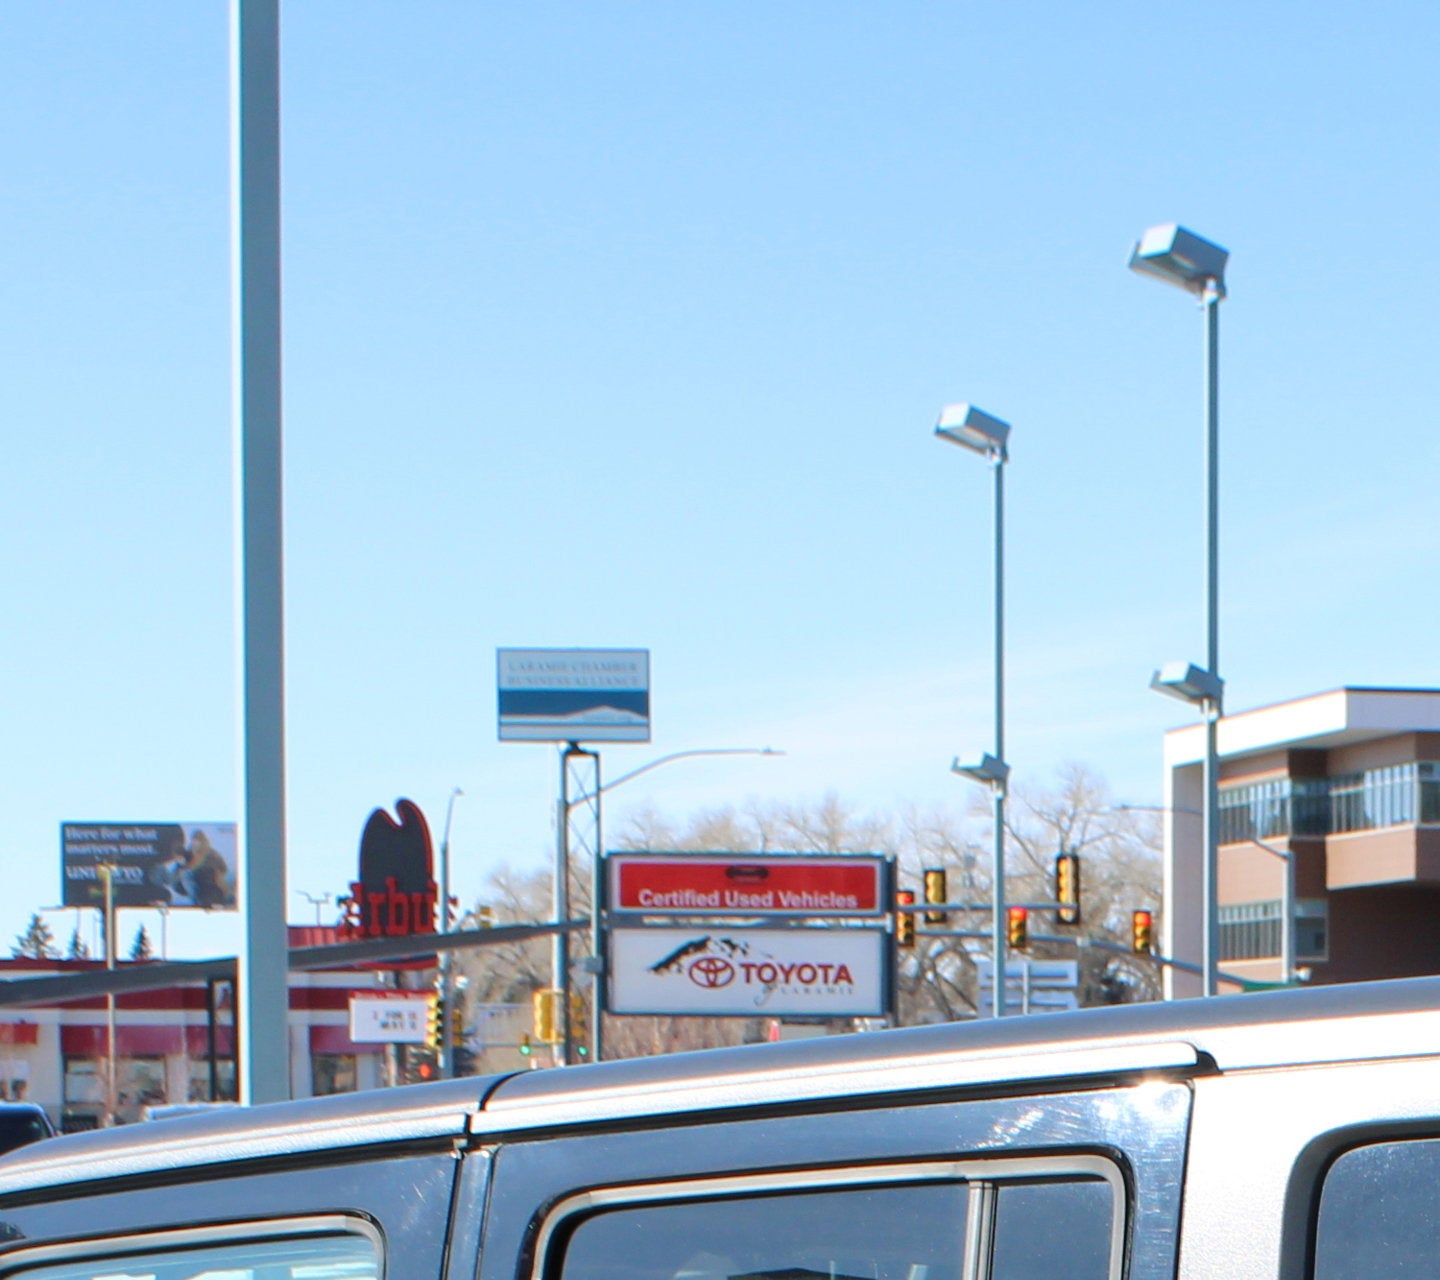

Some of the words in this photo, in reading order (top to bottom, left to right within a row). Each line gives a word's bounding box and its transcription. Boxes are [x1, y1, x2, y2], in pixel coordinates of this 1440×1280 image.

[122, 826, 157, 840] what
[639, 888, 720, 908] Certified
[725, 890, 775, 908] Used
[779, 890, 858, 909] Vehicles
[739, 963, 854, 985] TOYOTA
